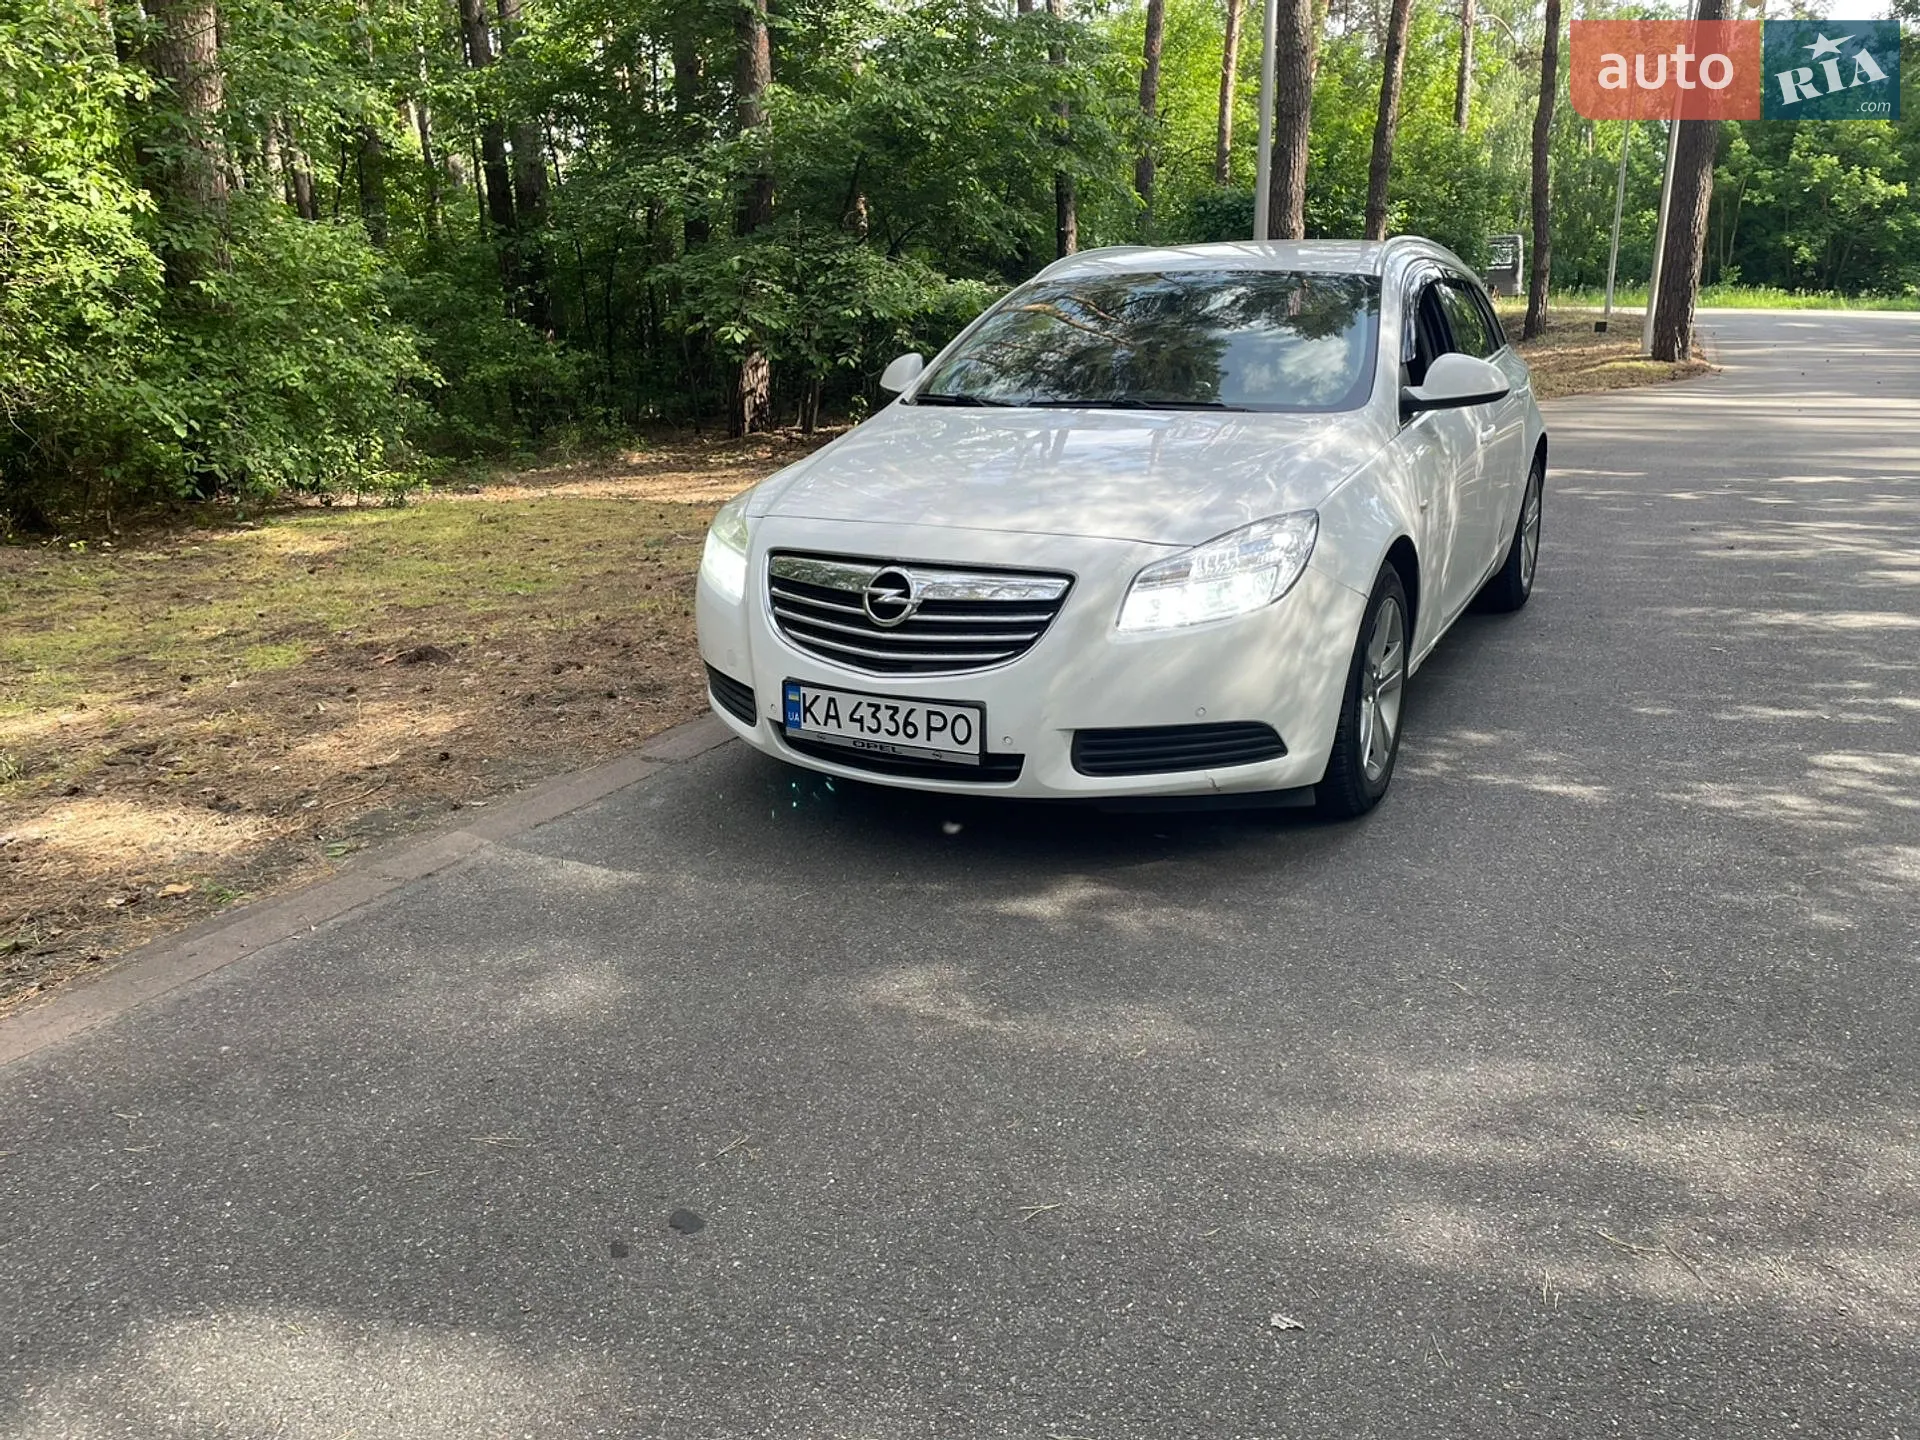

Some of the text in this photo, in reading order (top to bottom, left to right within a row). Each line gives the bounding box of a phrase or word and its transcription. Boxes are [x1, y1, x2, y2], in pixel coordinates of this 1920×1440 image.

[788, 712, 800, 722] UA
[802, 692, 972, 745] KA 4336 PO
[852, 739, 903, 755] OPEL
